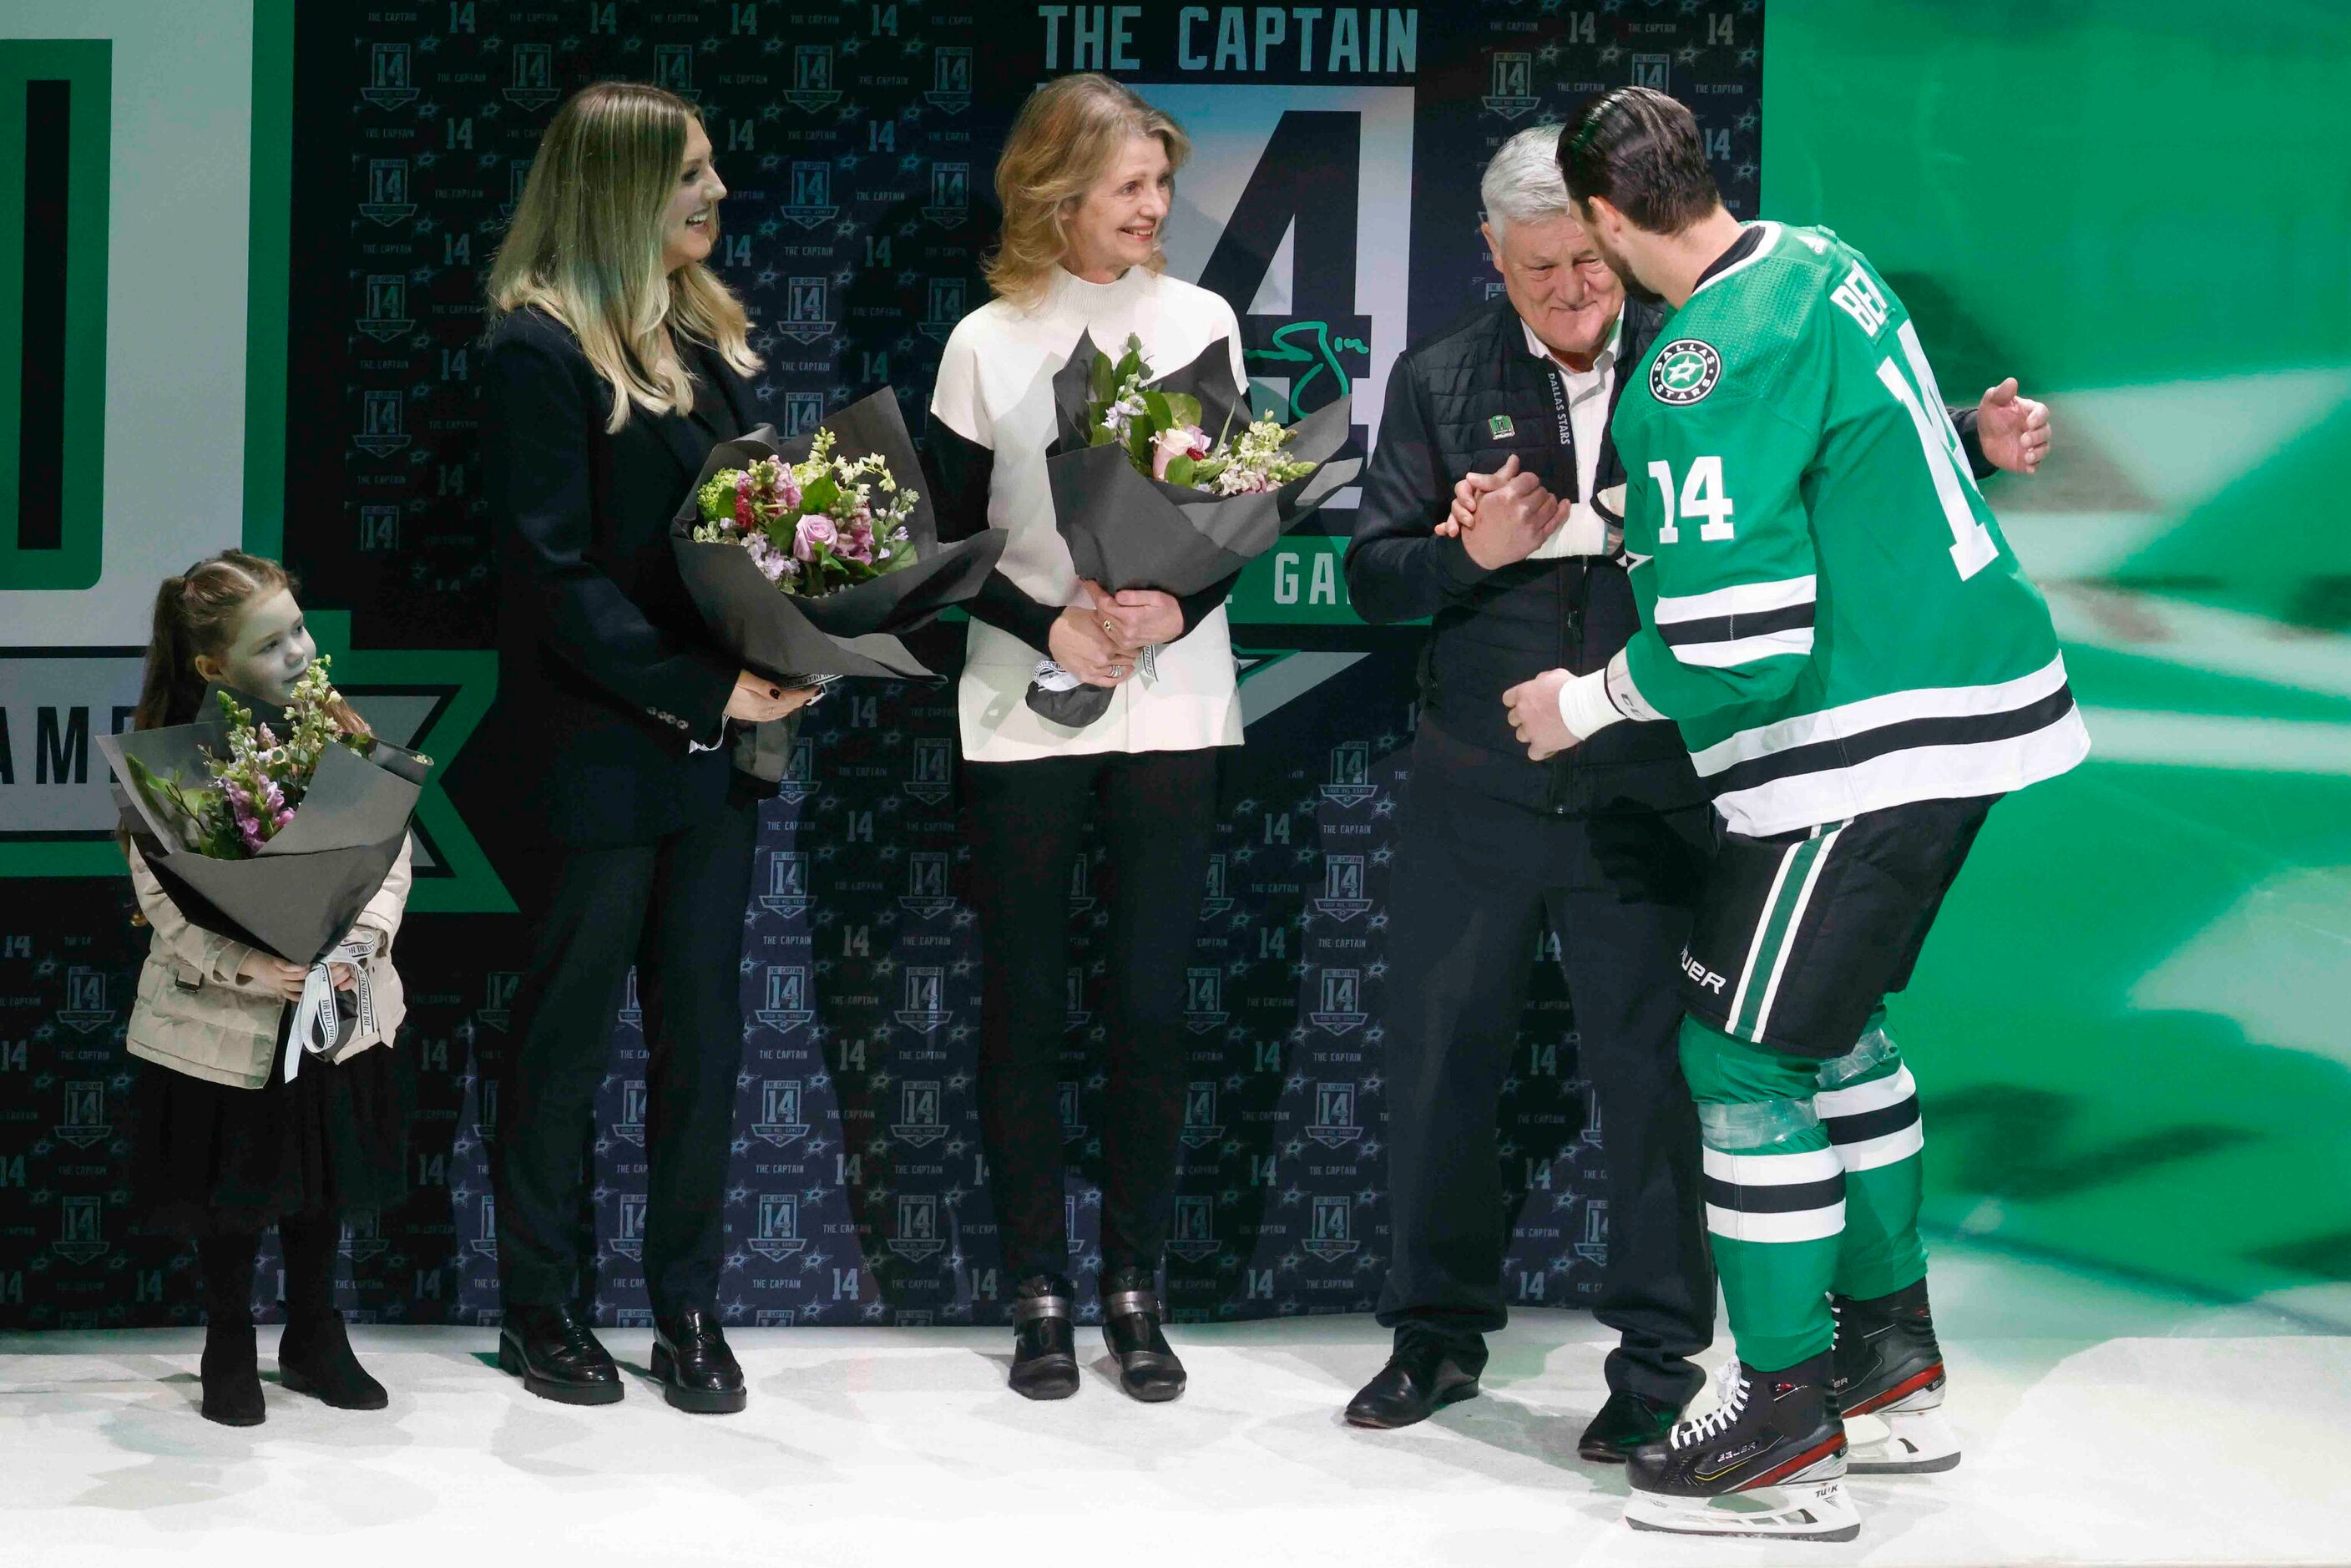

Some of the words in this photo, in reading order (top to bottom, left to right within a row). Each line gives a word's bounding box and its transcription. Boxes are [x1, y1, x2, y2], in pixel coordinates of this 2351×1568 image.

[368, 13, 381, 22] THE
[385, 13, 417, 22] CAPTAIN
[449, 3, 474, 33] 14
[589, 3, 616, 34] 14
[731, 3, 756, 35] 14
[872, 4, 897, 36] 14
[1570, 12, 1595, 43] 14
[1628, 23, 1641, 33] THE
[1645, 23, 1676, 33] CAPTAIN
[1707, 13, 1733, 45] 14
[1039, 5, 1141, 70] THE
[1178, 7, 1418, 73] CAPTAIN
[377, 53, 403, 85] 14
[518, 54, 544, 86] 14
[800, 56, 826, 88] 14
[940, 58, 966, 89] 14
[1498, 63, 1524, 95] 14
[1557, 83, 1570, 92] THE
[1574, 83, 1605, 92] CAPTAIN
[1695, 84, 1708, 94] THE
[1711, 84, 1743, 94] CAPTAIN
[446, 118, 473, 149] 14
[728, 119, 753, 150] 14
[868, 120, 894, 152] 14
[1704, 129, 1730, 160] 14
[375, 170, 401, 202] 14
[796, 172, 823, 204] 14
[857, 192, 870, 201] THE
[873, 192, 905, 201] CAPTAIN
[444, 234, 469, 266] 14
[725, 235, 751, 267] 14
[785, 246, 798, 255] THE
[801, 246, 833, 255] CAPTAIN
[865, 235, 891, 267] 14
[372, 286, 397, 317] 14
[793, 287, 820, 319] 14
[441, 349, 467, 381] 14
[781, 362, 795, 372] THE
[798, 362, 830, 372] CAPTAIN
[862, 351, 887, 382] 14
[1654, 344, 1715, 372] DALLAS
[1656, 378, 1711, 400] STARS
[369, 401, 396, 432] 14
[1548, 372, 1565, 411] DALLAS
[1557, 413, 1570, 445] STARS
[437, 464, 464, 496] 14
[1647, 456, 1734, 544] 14
[366, 516, 392, 548] 14
[851, 696, 877, 728] 14
[919, 749, 944, 780] 14
[847, 810, 873, 842] 14
[1264, 813, 1289, 845] 14
[1322, 825, 1336, 834] THE
[1339, 825, 1371, 834] CAPTAIN
[1251, 884, 1264, 893] THE
[1267, 884, 1299, 893] CAPTAIN
[1332, 866, 1357, 897] 14
[763, 936, 776, 945] THE
[780, 936, 811, 945] CAPTAIN
[843, 925, 868, 957] 14
[902, 937, 915, 946] THE
[919, 937, 951, 946] CAPTAIN
[1259, 927, 1285, 959] 14
[1318, 938, 1331, 948] THE
[1335, 938, 1367, 948] CAPTAIN
[73, 977, 99, 1009] 14
[771, 977, 798, 1009] 14
[911, 977, 937, 1009] 14
[1187, 979, 1214, 1010] 14
[1327, 979, 1352, 1010] 14
[421, 1039, 447, 1070] 14
[760, 1050, 772, 1060] THE
[776, 1050, 807, 1060] CAPTAIN
[839, 1039, 865, 1070] 14
[1254, 1040, 1281, 1072] 14
[1313, 1053, 1326, 1062] THE
[1330, 1053, 1362, 1062] CAPTAIN
[1529, 1044, 1556, 1075] 14
[70, 1092, 96, 1124] 14
[768, 1090, 793, 1122] 14
[907, 1091, 933, 1123] 14
[1184, 1093, 1209, 1124] 14
[1322, 1093, 1347, 1124] 14
[417, 1154, 444, 1186] 14
[756, 1165, 768, 1174] THE
[772, 1165, 804, 1174] CAPTAIN
[895, 1166, 908, 1175] THE
[912, 1166, 943, 1175] CAPTAIN
[1251, 1155, 1276, 1186] 14
[1309, 1166, 1322, 1175] THE
[1326, 1166, 1356, 1175] CAPTAIN
[764, 1205, 790, 1237] 14
[903, 1206, 928, 1237] 14
[1318, 1206, 1343, 1237] 14
[136, 1270, 162, 1302] 14
[415, 1268, 440, 1299] 14
[753, 1279, 766, 1288] THE
[770, 1279, 801, 1288] CAPTAIN
[832, 1268, 858, 1300] 14
[892, 1280, 905, 1289] THE
[908, 1280, 940, 1289] CAPTAIN
[970, 1268, 997, 1300] 14
[1247, 1268, 1272, 1299] 14
[1307, 1280, 1319, 1288] THE
[1322, 1280, 1353, 1288] CAPTAIN
[1519, 1270, 1544, 1301] 14
